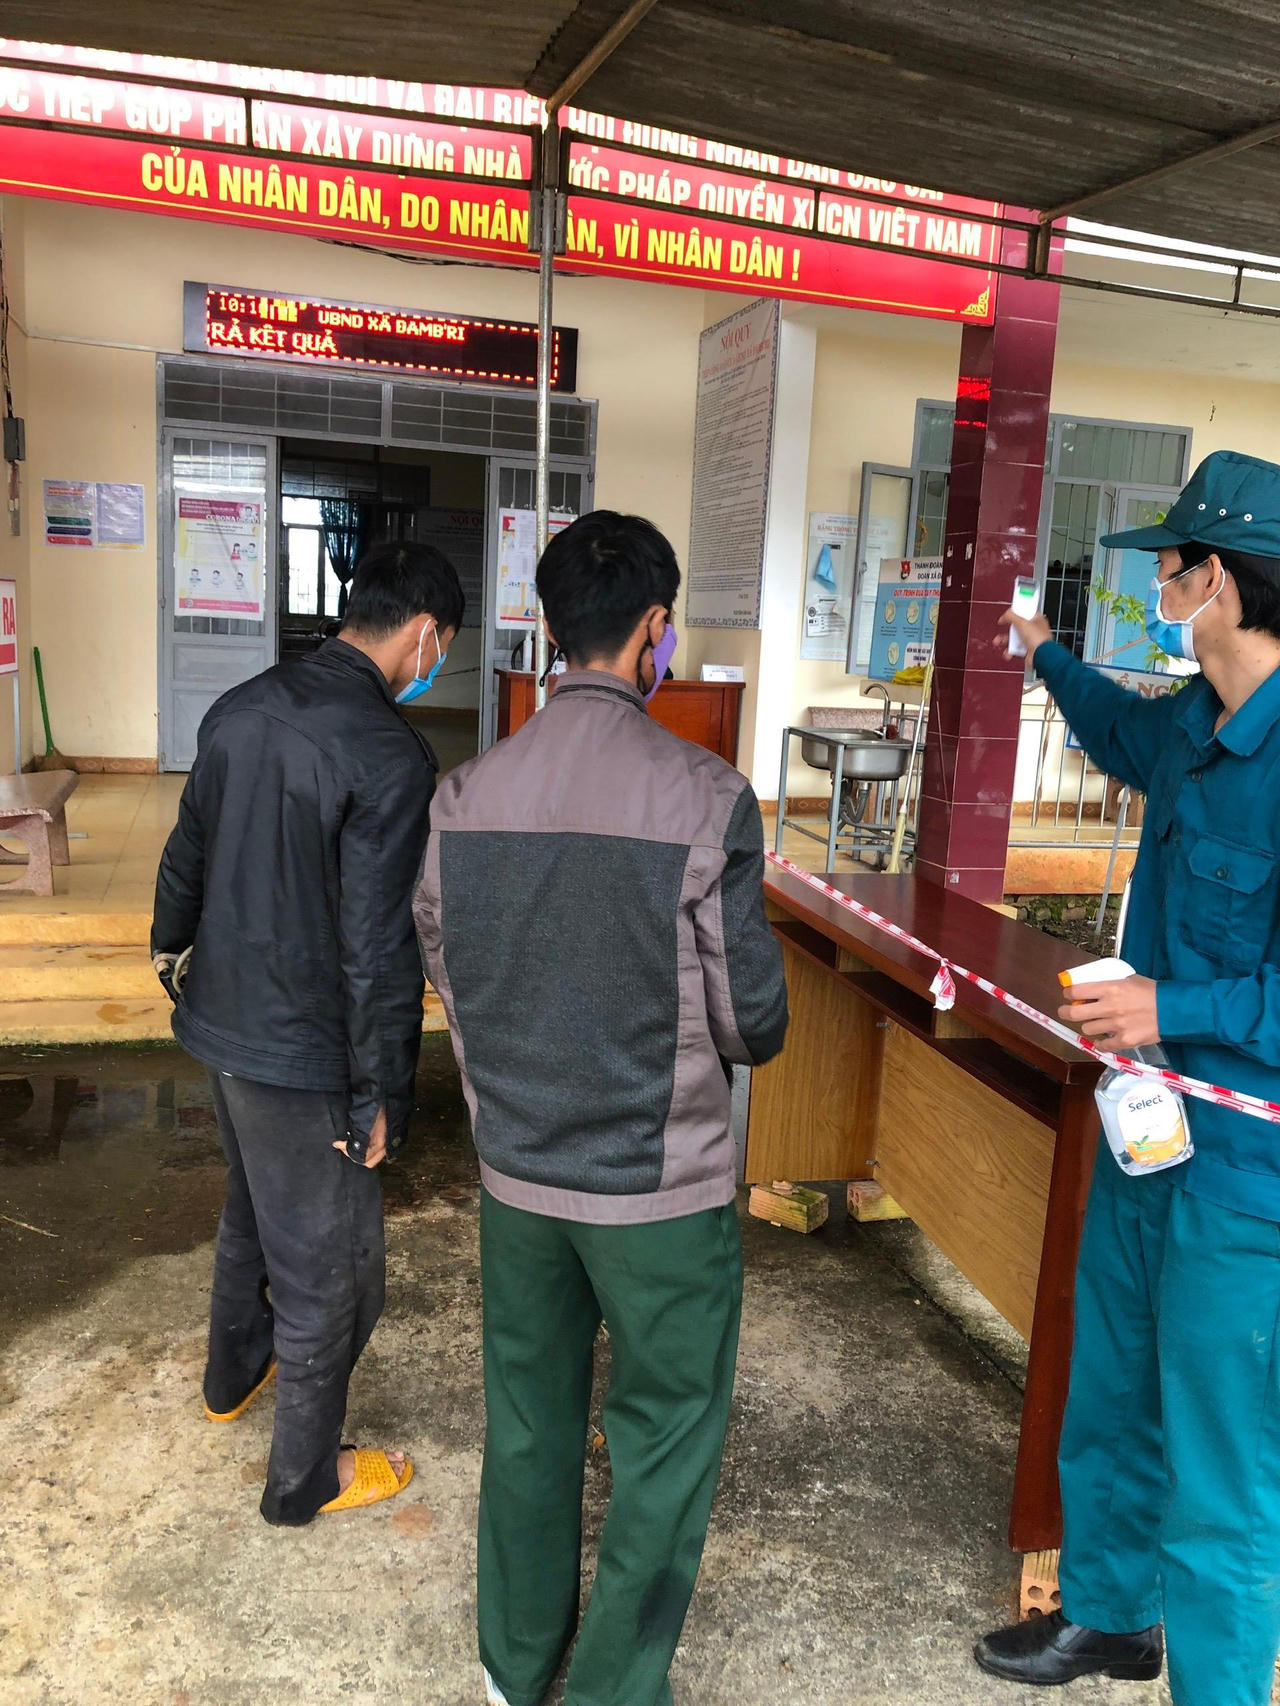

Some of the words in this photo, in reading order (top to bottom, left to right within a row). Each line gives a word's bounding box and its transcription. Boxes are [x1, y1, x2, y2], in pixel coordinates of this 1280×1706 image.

[142, 146, 209, 198] CỦA
[218, 163, 308, 213] NHÂN
[318, 175, 390, 229] DÂN,
[401, 192, 440, 231] DO
[449, 198, 529, 244] NHÂN
[566, 209, 604, 259] ÂN,
[614, 218, 639, 260] VÌ
[647, 227, 723, 270] NHÂN
[729, 236, 784, 279] DÂN
[463, 144, 523, 180] NHÀ
[618, 169, 691, 206] PHÁP
[924, 217, 982, 257] NAM
[318, 310, 363, 329] UBND
[1128, 1094, 1163, 1112] Select
